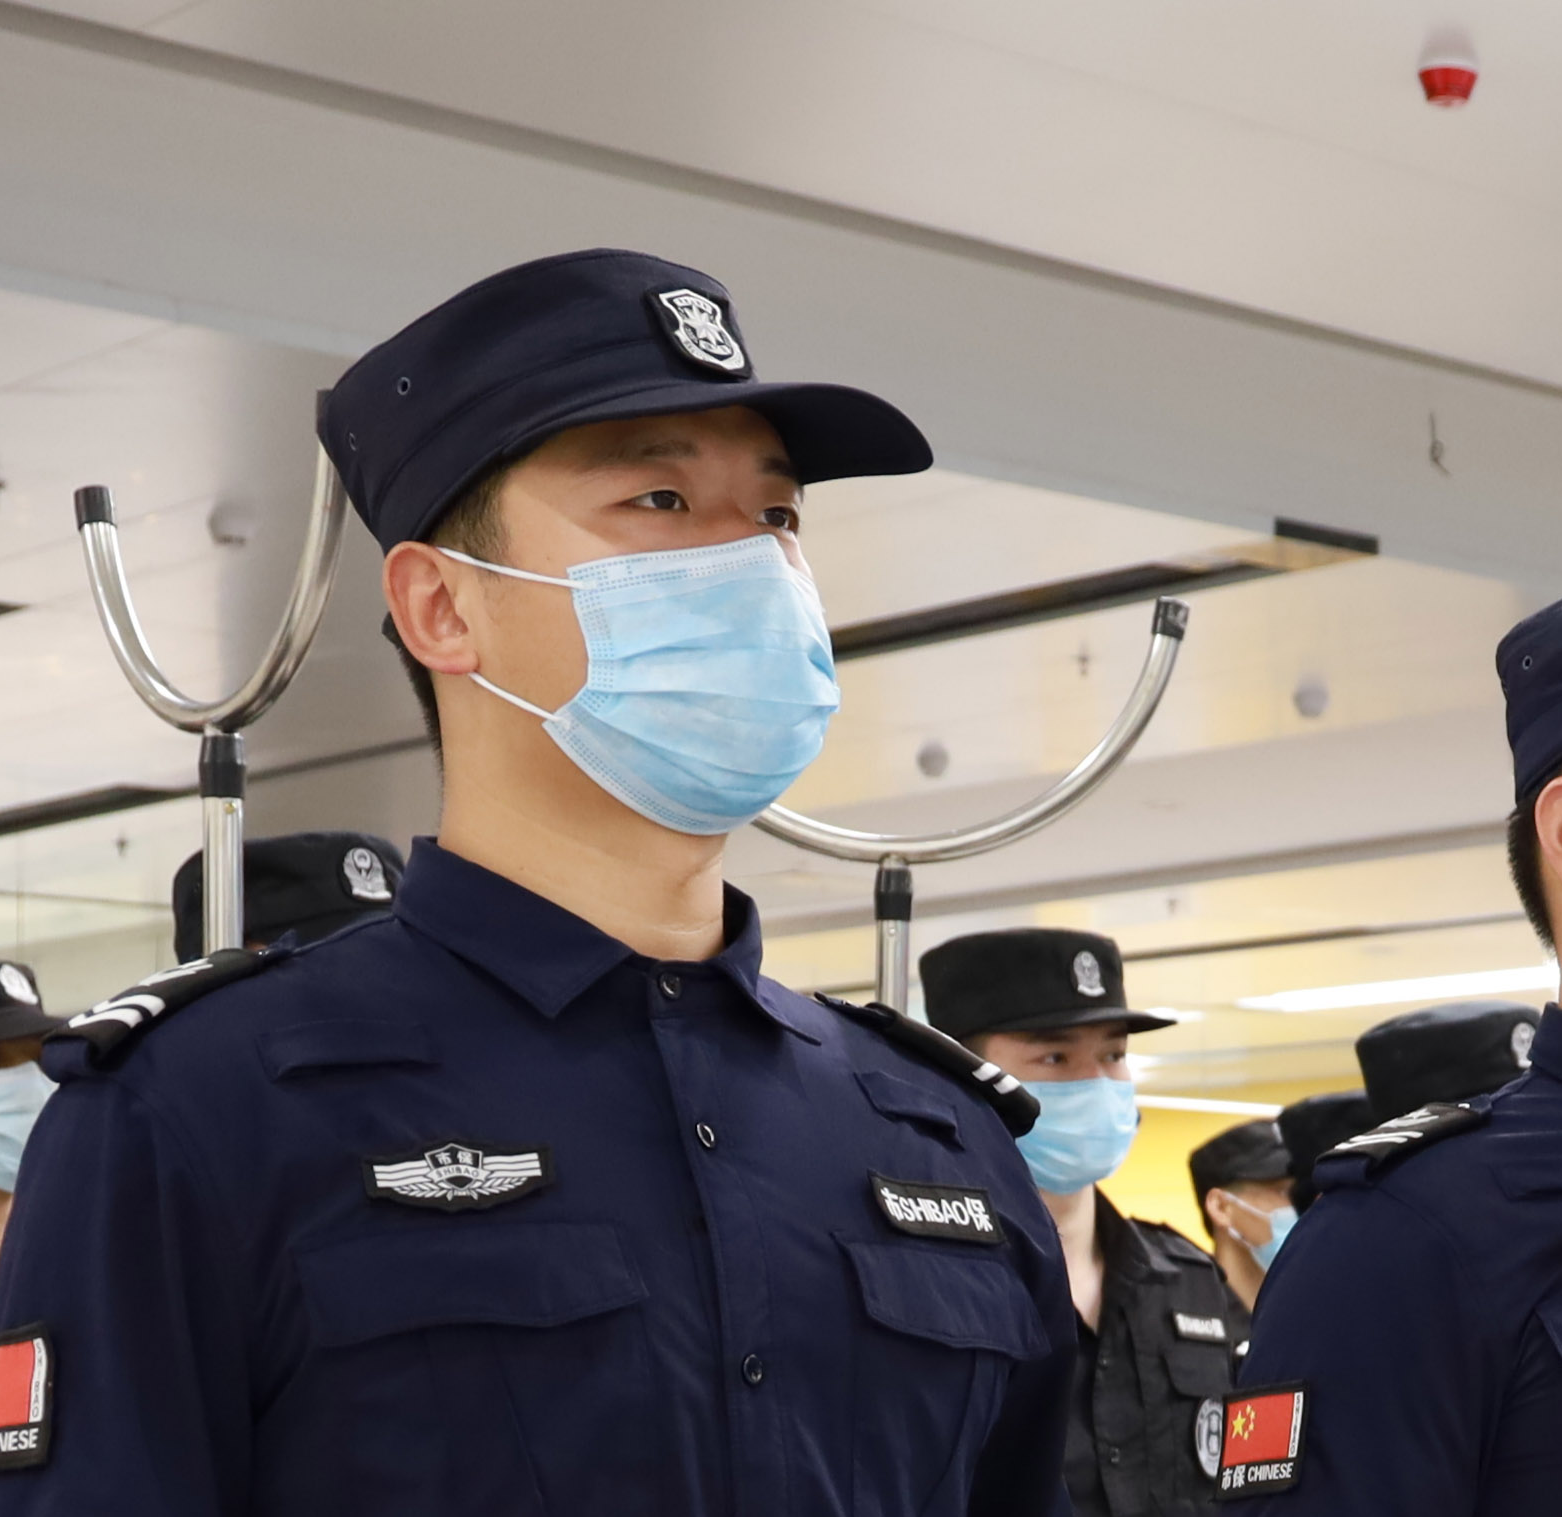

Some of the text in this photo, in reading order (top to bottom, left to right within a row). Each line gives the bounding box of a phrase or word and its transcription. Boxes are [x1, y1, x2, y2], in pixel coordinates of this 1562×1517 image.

[435, 1151, 474, 1166] 市保
[437, 1169, 480, 1179] SHIBAO
[1221, 1462, 1294, 1490] 市保 CHINESE
